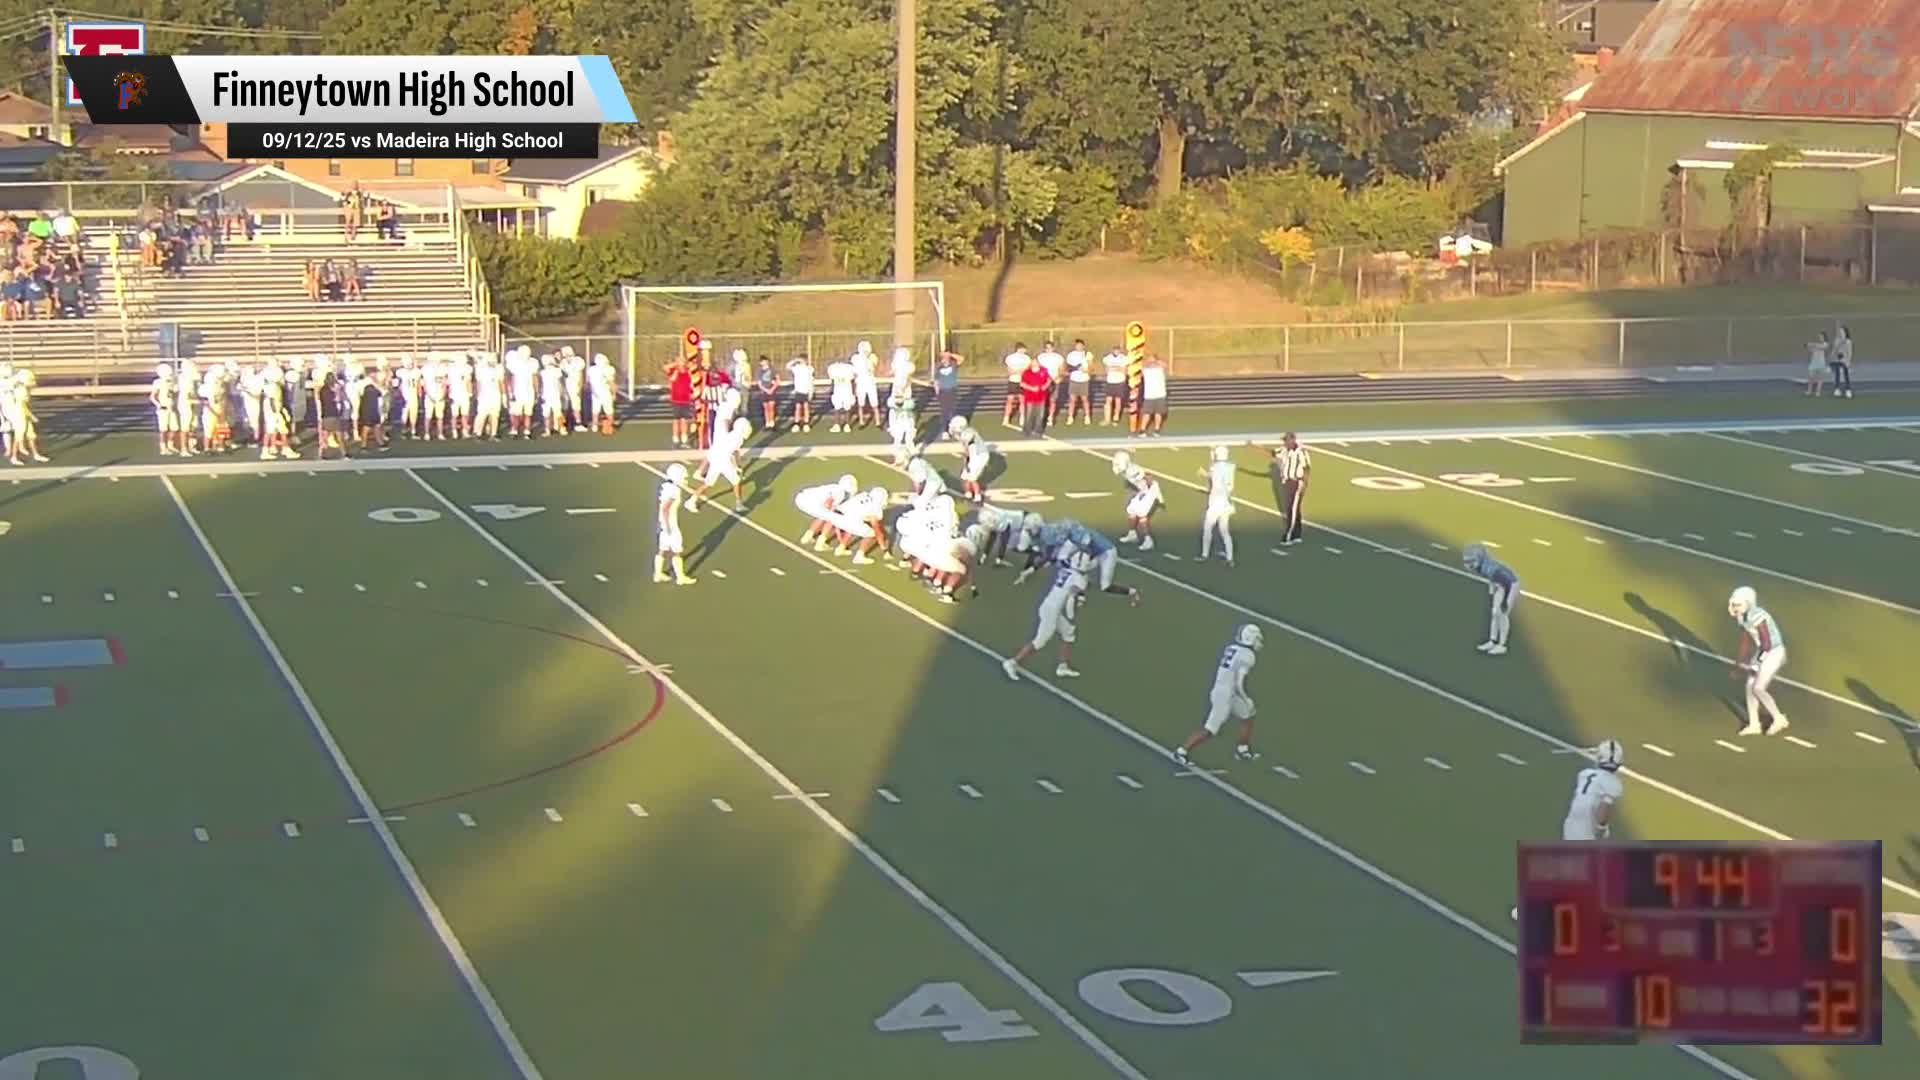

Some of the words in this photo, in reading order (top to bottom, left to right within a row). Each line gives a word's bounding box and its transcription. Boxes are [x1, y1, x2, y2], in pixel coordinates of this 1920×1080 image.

[1553, 903, 1578, 956] 0
[1830, 908, 1857, 963] 0
[873, 966, 1234, 1043] 40
[1633, 975, 1672, 1029] 10
[1803, 979, 1858, 1034] 32
